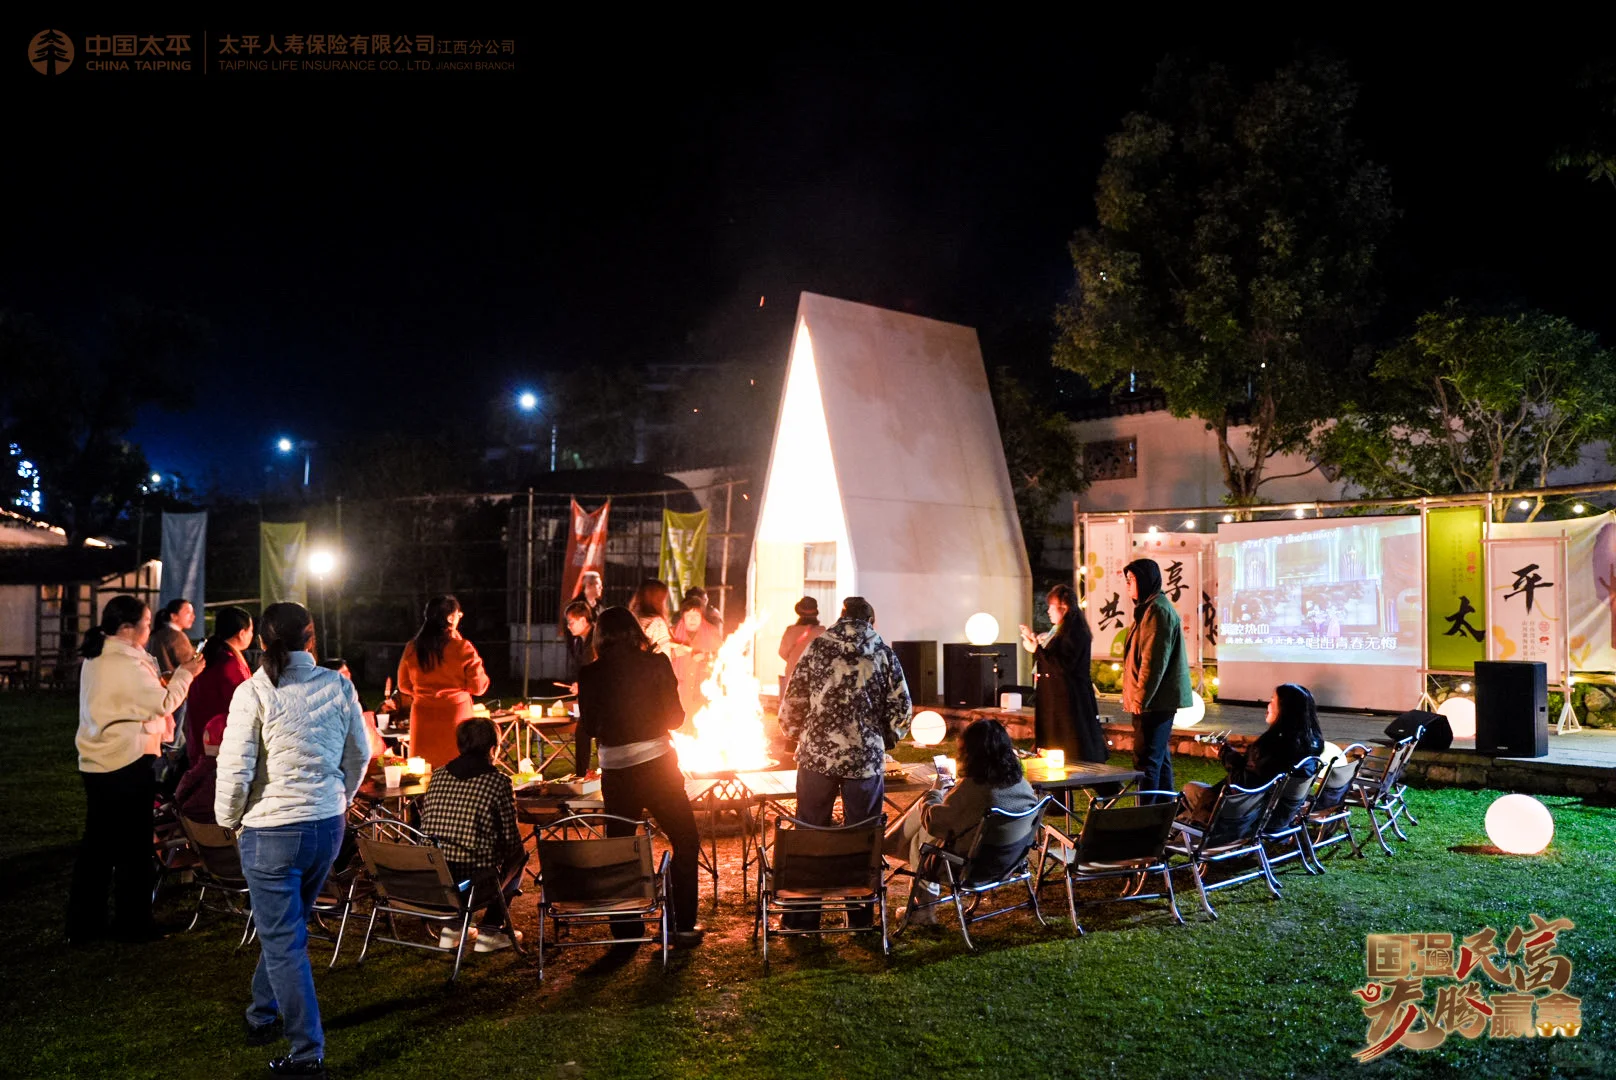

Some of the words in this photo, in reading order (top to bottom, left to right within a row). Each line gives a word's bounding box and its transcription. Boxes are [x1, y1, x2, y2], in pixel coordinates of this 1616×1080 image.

[1164, 560, 1189, 602] 享
[1503, 563, 1554, 615] 平
[1098, 592, 1125, 631] 共
[1443, 595, 1486, 642] 太
